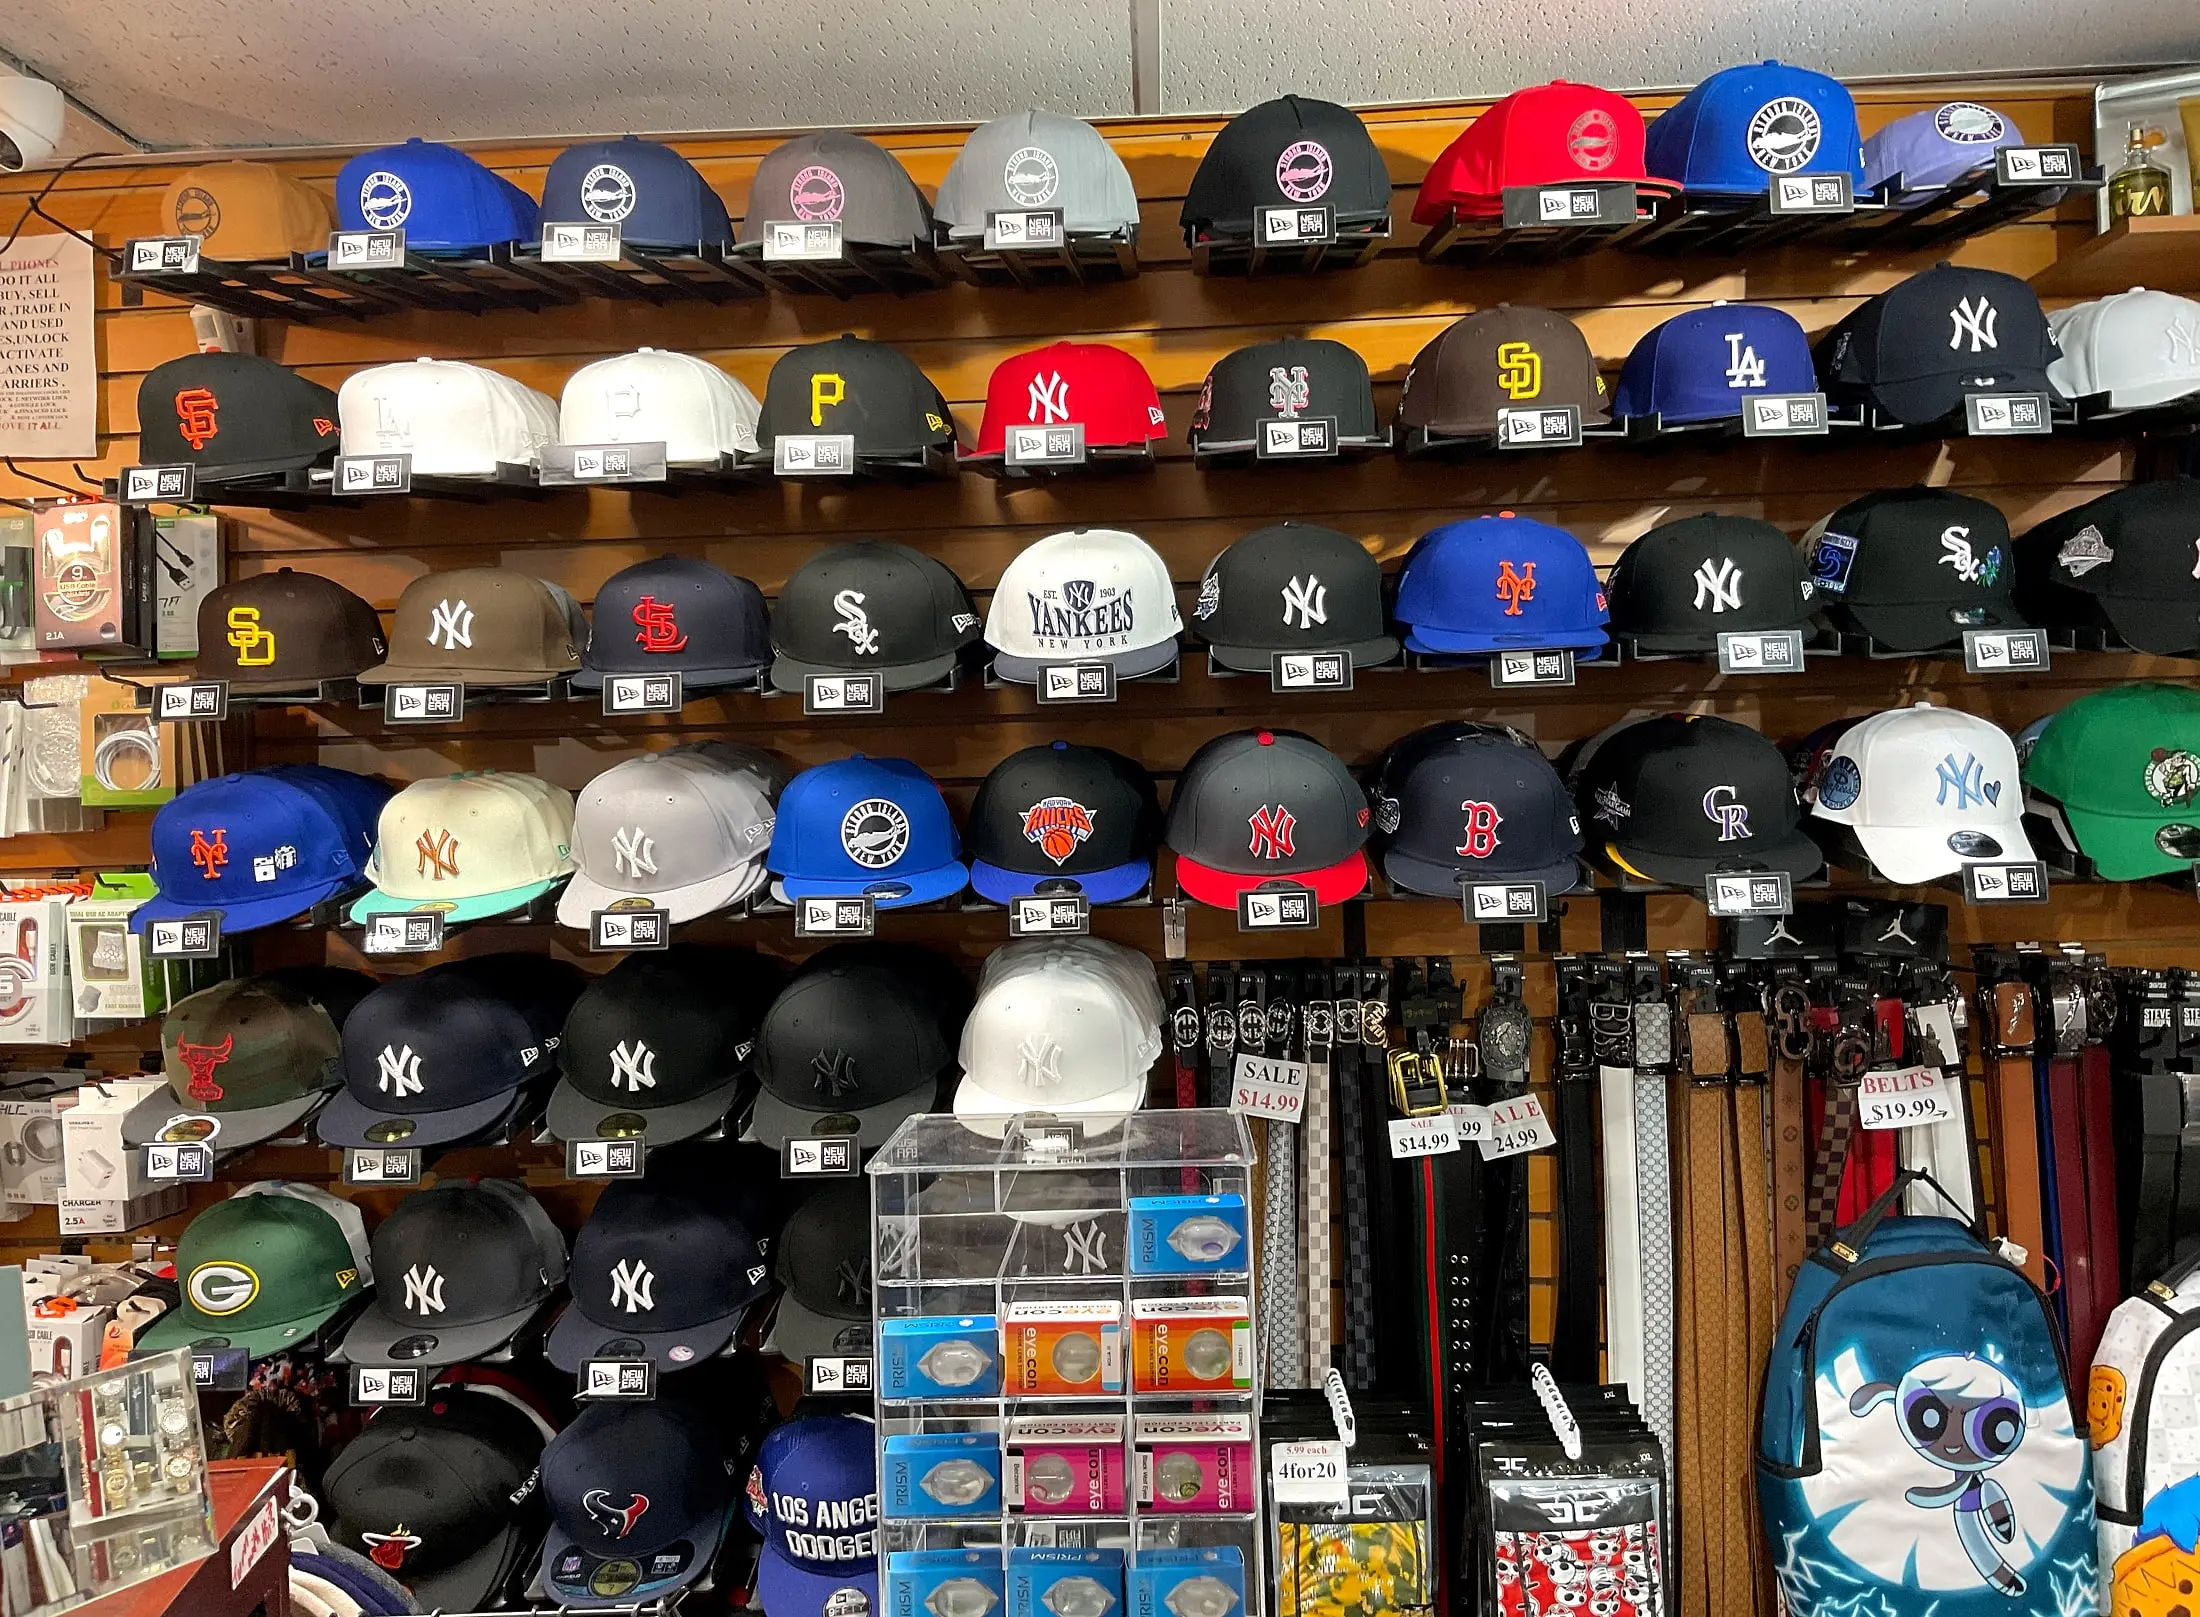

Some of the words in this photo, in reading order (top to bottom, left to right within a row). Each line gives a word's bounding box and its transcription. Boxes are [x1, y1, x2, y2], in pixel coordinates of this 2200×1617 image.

[2043, 155, 2066, 164] NEW
[2044, 163, 2066, 173] ERA
[1573, 196, 1593, 205] NEW
[1573, 204, 1594, 213] ERA
[1300, 214, 1323, 224] NEW
[1300, 224, 1323, 235] ERA
[370, 239, 390, 248] NEW
[370, 248, 390, 257] ERA
[20, 275, 32, 286] IT
[37, 274, 60, 284] ALL
[29, 288, 60, 298] SELL
[60, 302, 71, 312] IN
[2, 320, 28, 330] AND
[31, 318, 63, 329] USED
[42, 362, 70, 372] AND
[0, 378, 59, 389] ARRIERS
[811, 373, 846, 426] P
[1790, 404, 1813, 413] NEW
[2013, 403, 2035, 412] NEW
[1543, 416, 1567, 426] NEW
[1791, 412, 1814, 423] ERA
[2013, 412, 2036, 422] ERA
[40, 422, 62, 430] ALL
[1543, 424, 1567, 435] ERA
[1301, 428, 1323, 436] NEW
[1301, 436, 1324, 446] ERA
[160, 473, 182, 483] NEW
[160, 482, 180, 492] ERA
[72, 566, 83, 580] 9
[1043, 589, 1058, 600] EST.
[1027, 588, 1134, 637] YANKEES
[46, 632, 64, 640] 2.1A
[1038, 639, 1069, 650] NEW
[1084, 635, 1128, 650] YORK
[1316, 661, 1338, 670] NEW
[1536, 656, 1559, 665] NEW
[1316, 669, 1338, 680] ERA
[1537, 665, 1560, 674] ERA
[1080, 673, 1101, 682] NEW
[646, 684, 668, 692] NEW
[846, 684, 868, 692] NEW
[1080, 682, 1101, 692] ERA
[194, 691, 214, 700] NEW
[647, 692, 668, 702] ERA
[846, 692, 868, 702] ERA
[194, 700, 214, 710] ERA
[1025, 805, 1091, 833] KNICKS
[1455, 800, 1503, 858] B
[2010, 873, 2032, 882] NEW
[2011, 882, 2033, 892] ERA
[1508, 892, 1531, 901] NEW
[1282, 900, 1305, 909] NEW
[1509, 900, 1532, 912] ERA
[838, 906, 860, 915] NEW
[1282, 908, 1305, 919] ERA
[838, 914, 860, 925] ERA
[634, 922, 656, 930] NEW
[185, 927, 206, 937] NEW
[634, 930, 656, 940] ERA
[185, 936, 206, 946] ERA
[2143, 1008, 2171, 1018] STEVE
[2143, 1018, 2171, 1027] MADDEN
[1244, 1061, 1301, 1086] SALE
[1864, 1071, 1935, 1095] BELTS
[1238, 1089, 1298, 1112] $14.99
[1492, 1101, 1540, 1126] ALE
[1871, 1098, 1936, 1121] $19.99
[1410, 1119, 1434, 1129] SALE
[1399, 1133, 1449, 1153] $14.99
[610, 1148, 632, 1157] NEW
[824, 1146, 845, 1156] NEW
[180, 1152, 200, 1161] NEW
[824, 1155, 846, 1166] ERA
[180, 1161, 200, 1171] ERA
[610, 1157, 632, 1168] ERA
[65, 1217, 85, 1225] 2.5A
[1143, 1218, 1154, 1264] PRISM
[1015, 1308, 1112, 1316] eyecon
[1027, 1327, 1038, 1388] eyecon
[1158, 1324, 1168, 1385] eyecon
[622, 1369, 644, 1379] NEW
[846, 1364, 868, 1375] NEW
[392, 1376, 413, 1385] NEW
[622, 1378, 644, 1389] ERA
[846, 1374, 868, 1384] ERA
[392, 1385, 413, 1395] ERA
[1604, 1391, 1615, 1399] XXL
[1018, 1427, 1116, 1435] eyecon
[1144, 1425, 1242, 1434] eyecon
[1286, 1446, 1304, 1454] 5.99
[1306, 1446, 1327, 1454] each
[1639, 1453, 1653, 1462] XXL
[1279, 1462, 1336, 1479] 4for20
[1088, 1449, 1100, 1510] eyecon
[1218, 1447, 1229, 1509] eyecon
[896, 1462, 908, 1506] PRISM
[772, 1491, 809, 1527] LOS
[816, 1494, 877, 1529] ANGE
[786, 1528, 878, 1562] DODGE
[1030, 1553, 1082, 1562] PRISM
